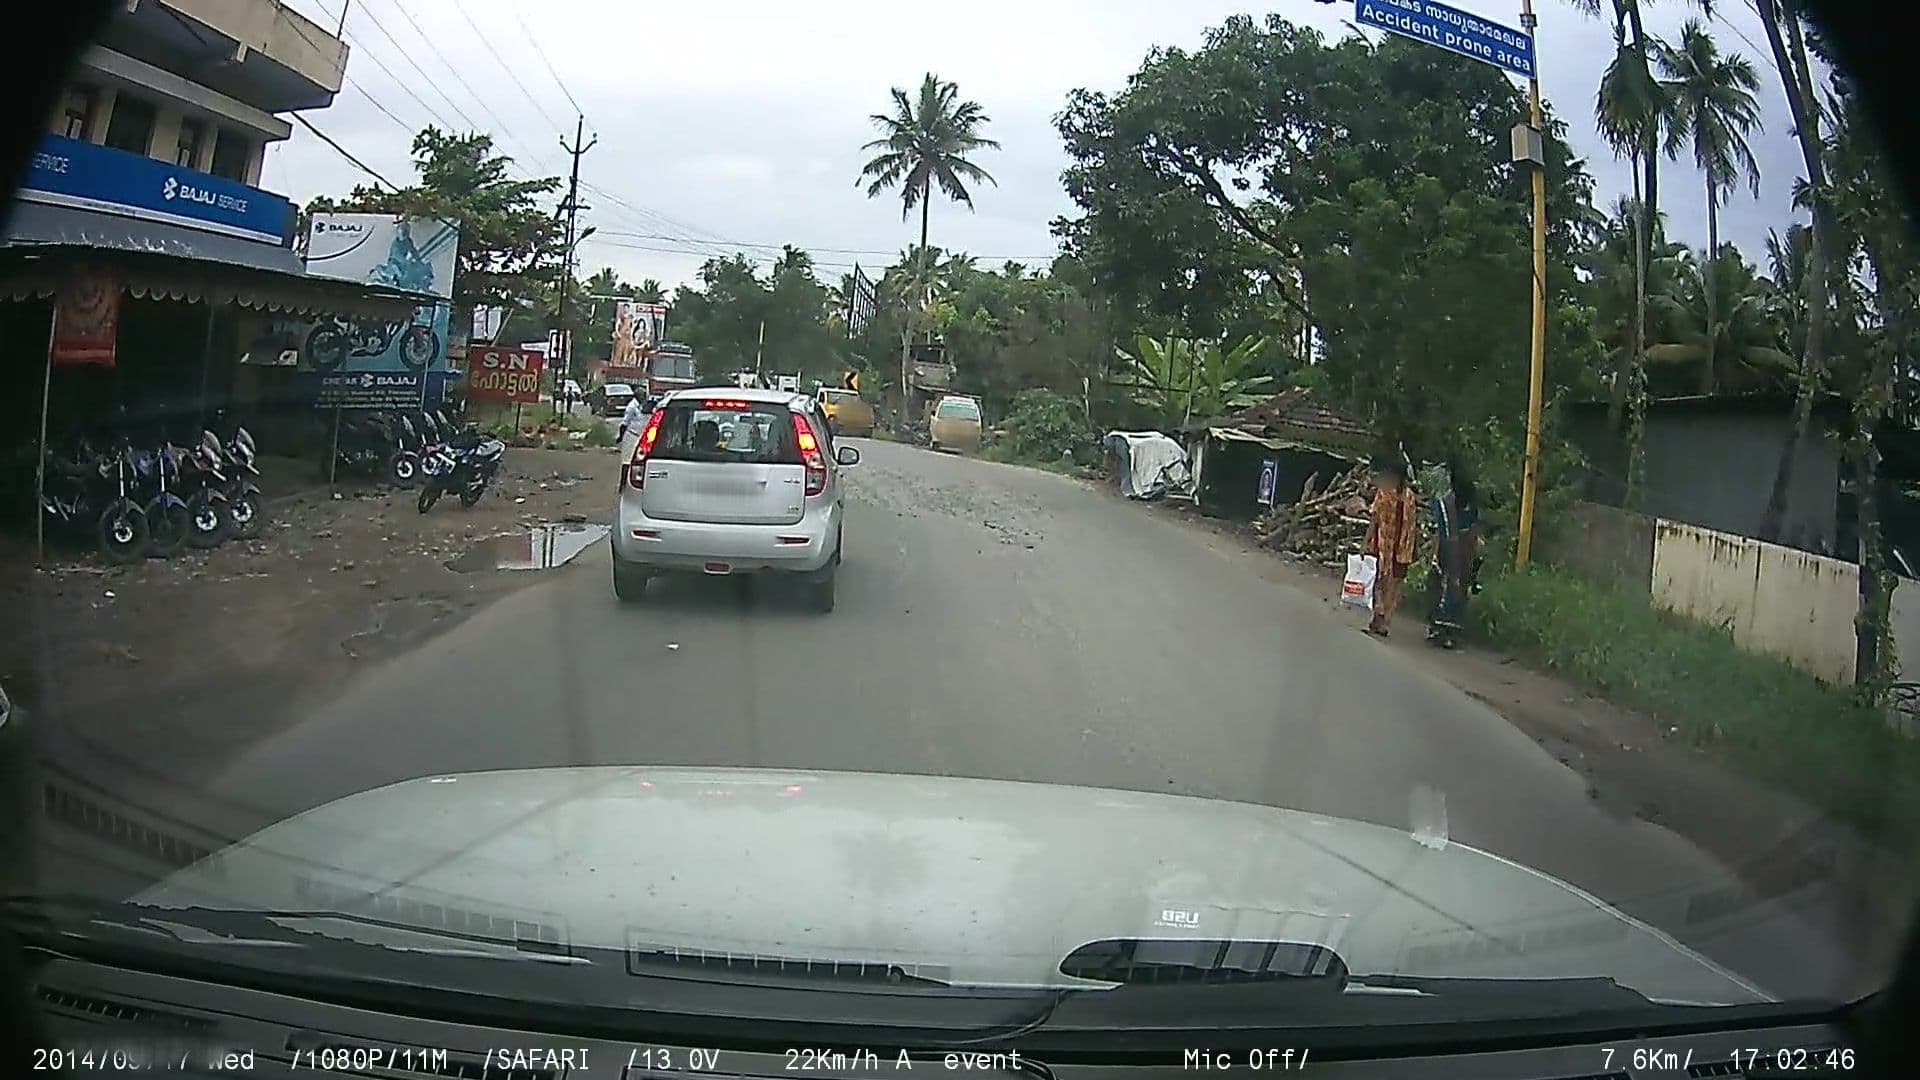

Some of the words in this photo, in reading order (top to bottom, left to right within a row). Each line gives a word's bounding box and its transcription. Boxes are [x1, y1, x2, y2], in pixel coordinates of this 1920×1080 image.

[1362, 4, 1439, 39] Accident
[1445, 31, 1492, 58] prone
[1497, 50, 1531, 71] area
[179, 185, 216, 204] BAJAJ
[218, 194, 248, 213] SERVICE
[329, 223, 363, 232] BAJAJ
[483, 351, 529, 370] S.N
[376, 376, 418, 386] BAJAJ
